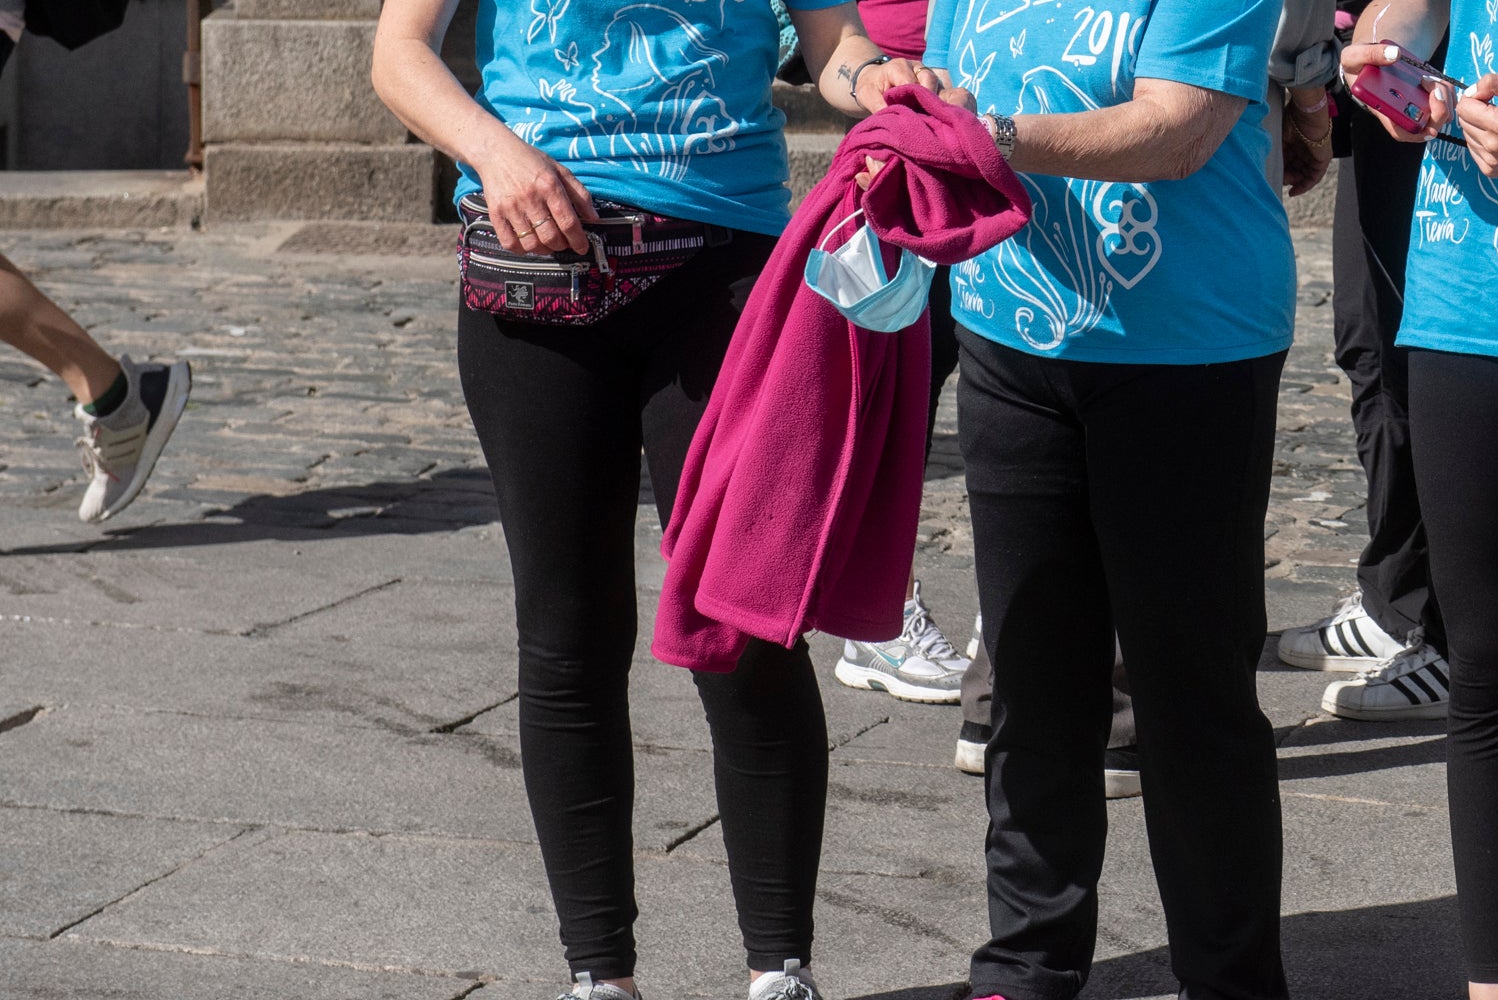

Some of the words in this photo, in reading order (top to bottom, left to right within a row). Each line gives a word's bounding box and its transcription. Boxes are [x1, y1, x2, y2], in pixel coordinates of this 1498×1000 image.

[1417, 163, 1465, 218] Madre
[1415, 210, 1470, 250] Tierra
[955, 275, 995, 319] Tierra
